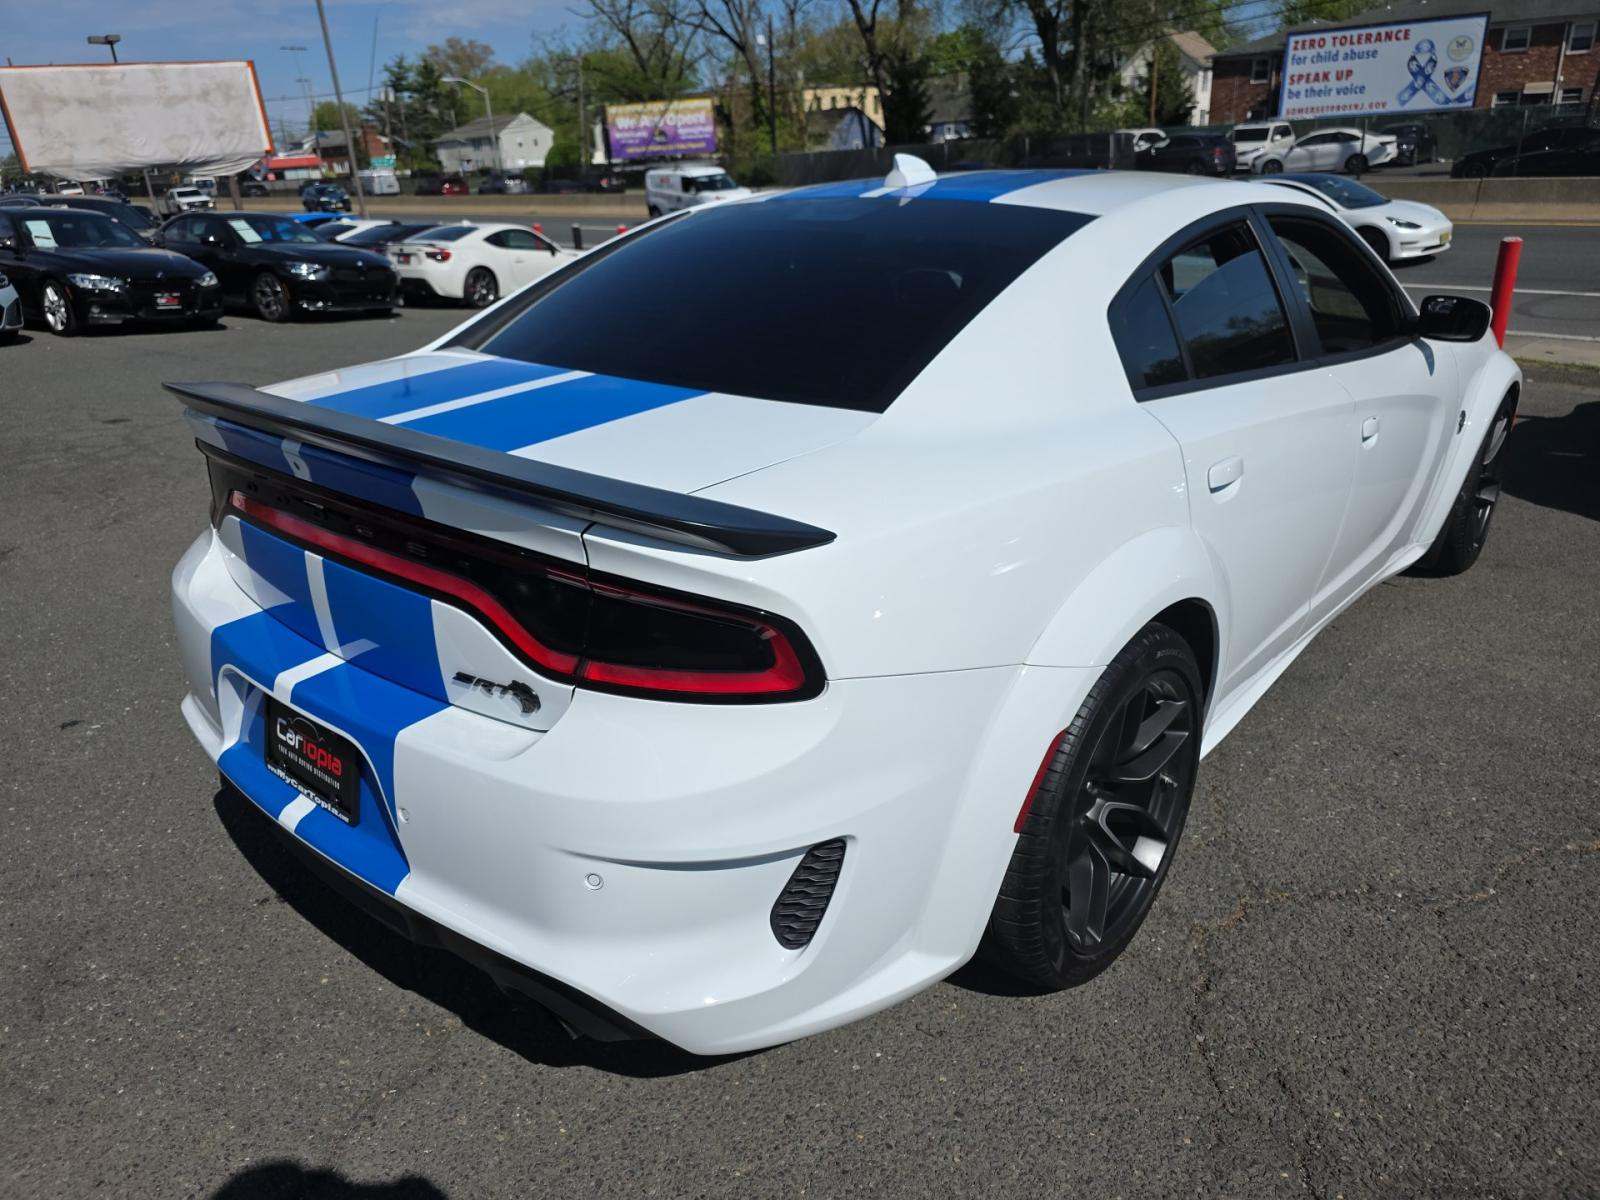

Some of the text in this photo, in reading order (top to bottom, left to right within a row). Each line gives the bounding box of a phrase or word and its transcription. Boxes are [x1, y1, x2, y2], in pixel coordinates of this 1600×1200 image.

[1293, 29, 1411, 51] ZERO TOLERANCE
[1291, 48, 1378, 66] for child abuse
[1289, 69, 1353, 86] SPEAK UP
[1287, 84, 1366, 100] be their voice
